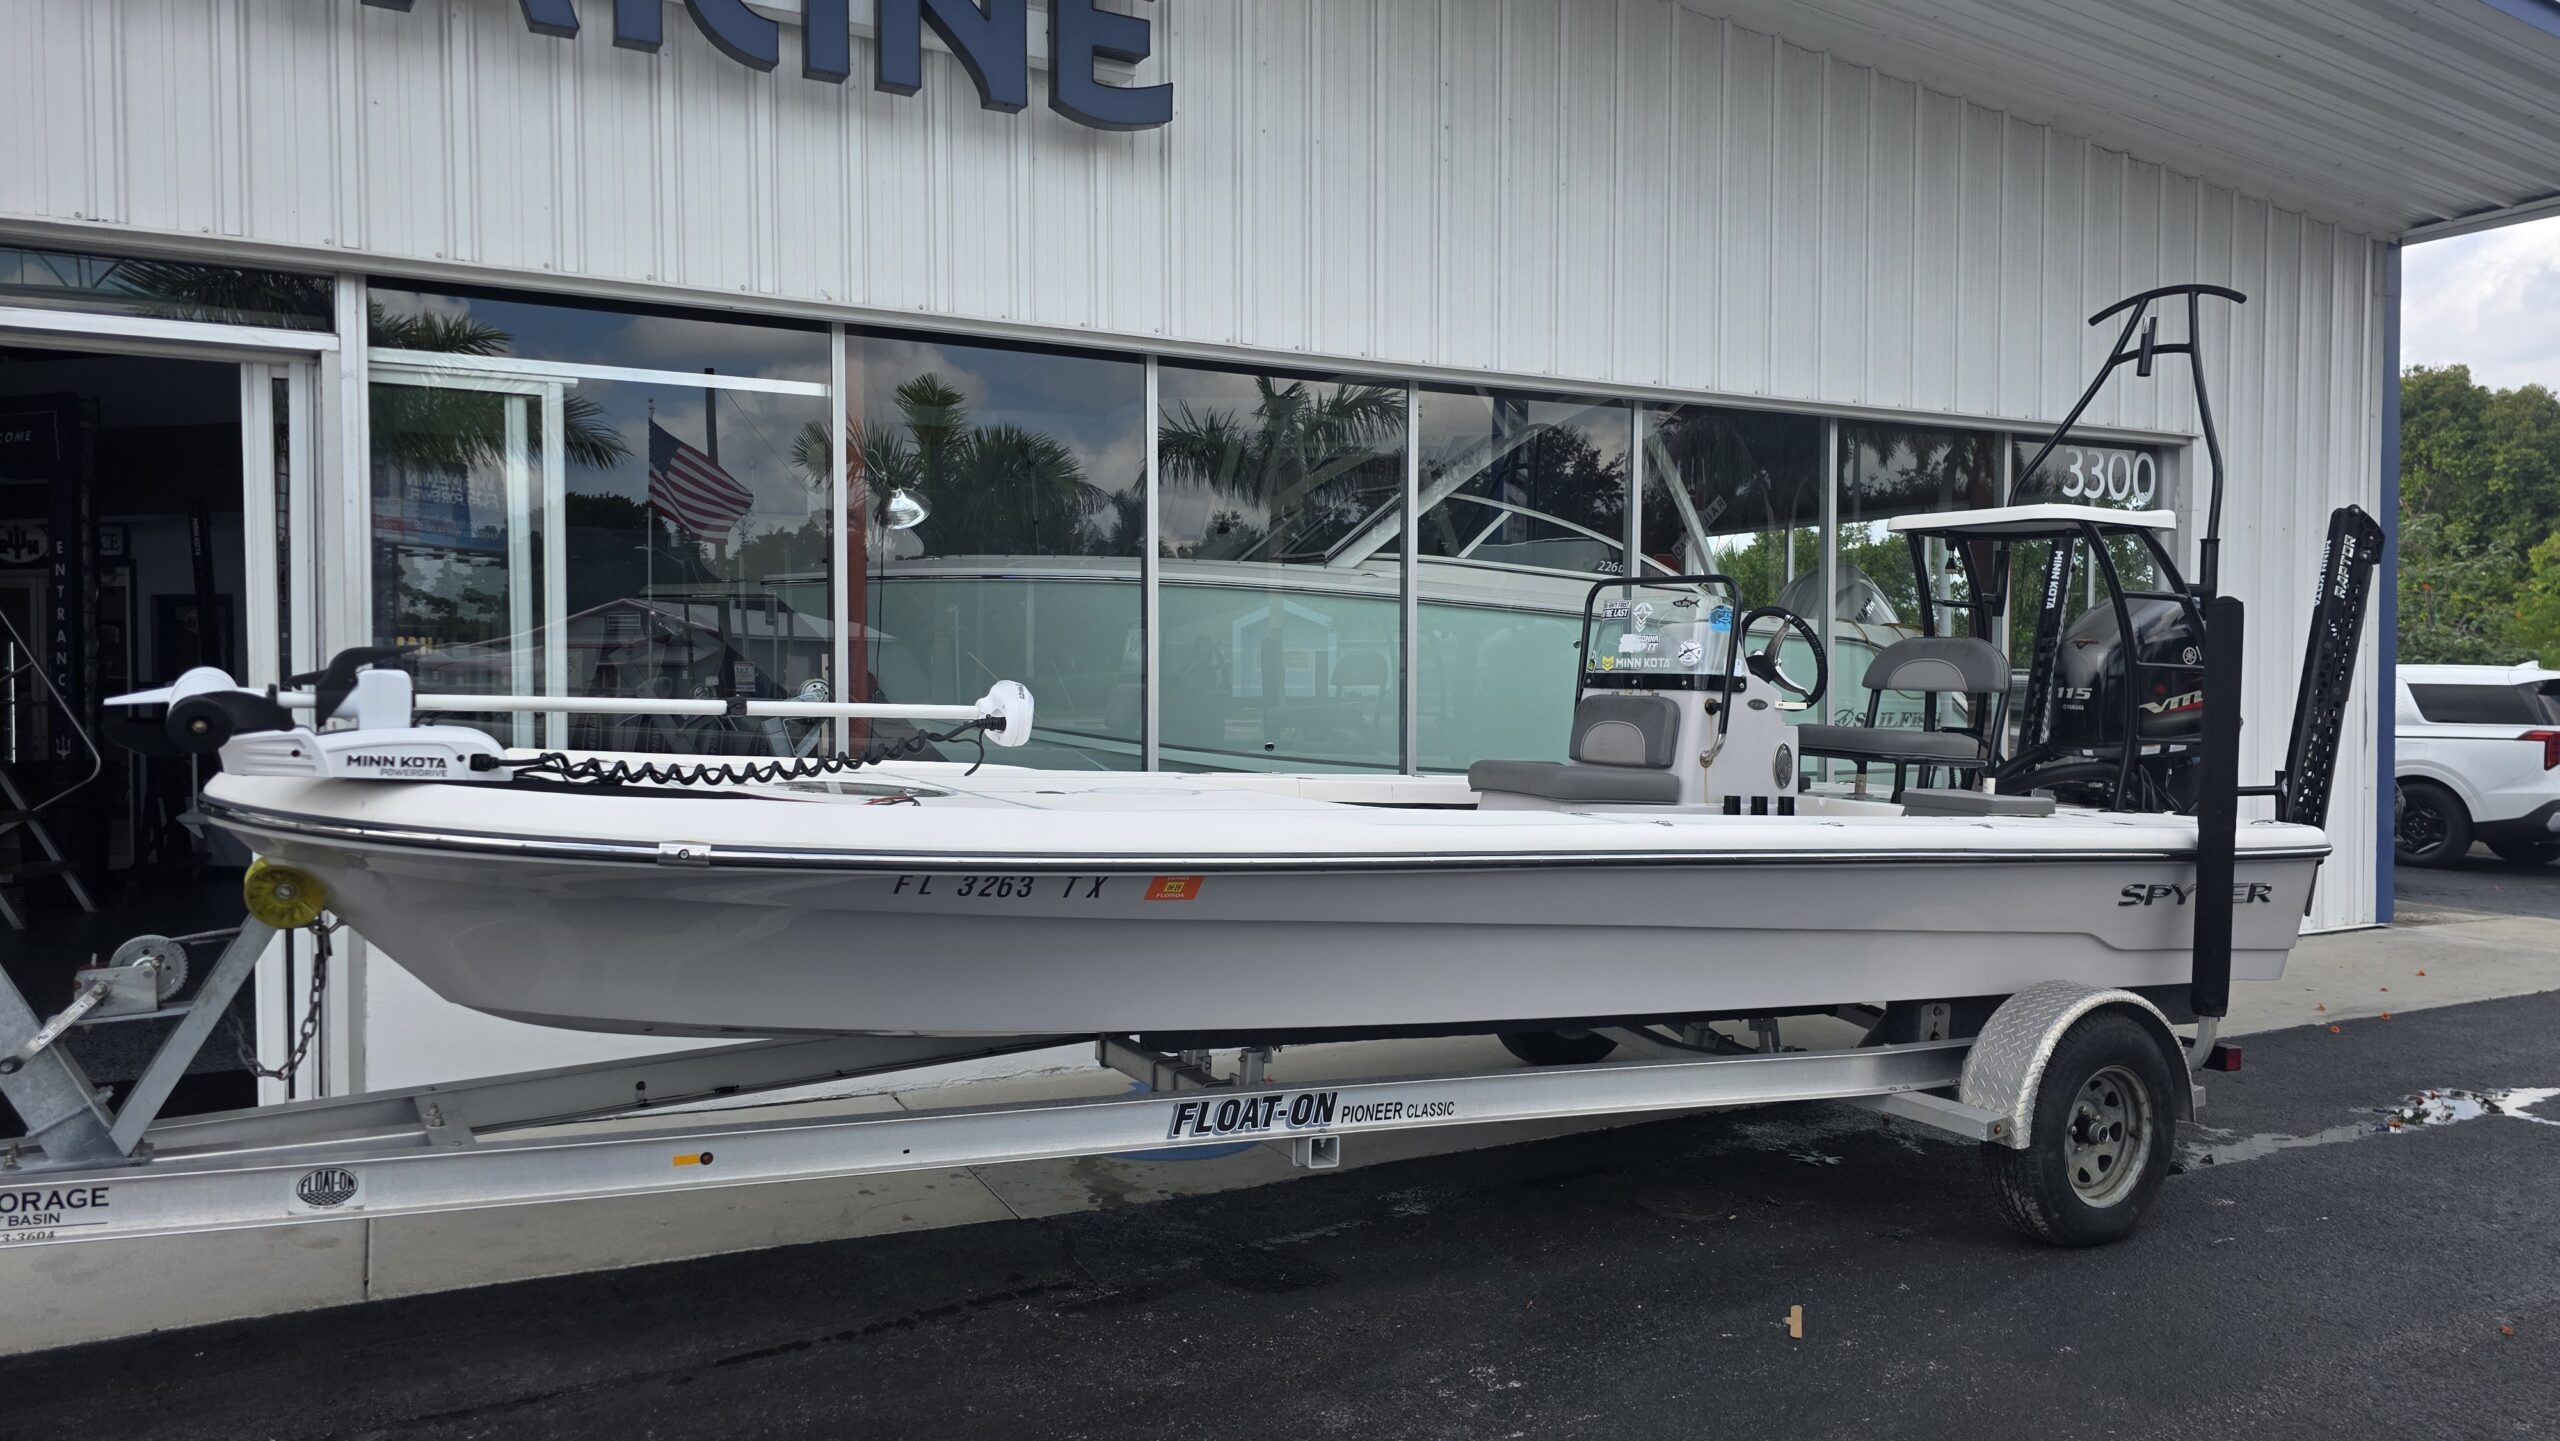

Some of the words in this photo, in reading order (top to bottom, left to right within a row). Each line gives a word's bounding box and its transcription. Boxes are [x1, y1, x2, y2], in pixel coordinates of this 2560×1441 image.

[2062, 447, 2156, 502] 3300
[2050, 550, 2064, 580] MINN
[2320, 539, 2332, 573] MINN
[2333, 534, 2356, 599] RAPTOR
[2045, 581, 2059, 610] KOTA
[55, 540, 67, 704] ENTRANC
[1616, 657, 1642, 668] MINN
[1643, 657, 1672, 668] KOTA
[2057, 687, 2092, 700] 115
[2067, 703, 2084, 711] YAMAHA
[347, 755, 395, 767] MINN
[399, 757, 448, 768] KOTA
[379, 768, 448, 777] POWERDRIVE
[893, 874, 934, 895] FL
[957, 876, 1035, 898] 3263
[2117, 883, 2272, 906] SPYER
[1168, 1092, 1338, 1138] FLOAT-ON
[1341, 1101, 1403, 1124] PIONEER
[1406, 1101, 1455, 1119] CLASSIC
[300, 1170, 355, 1195] FLOAT-ON
[8, 1213, 61, 1227] BASIN
